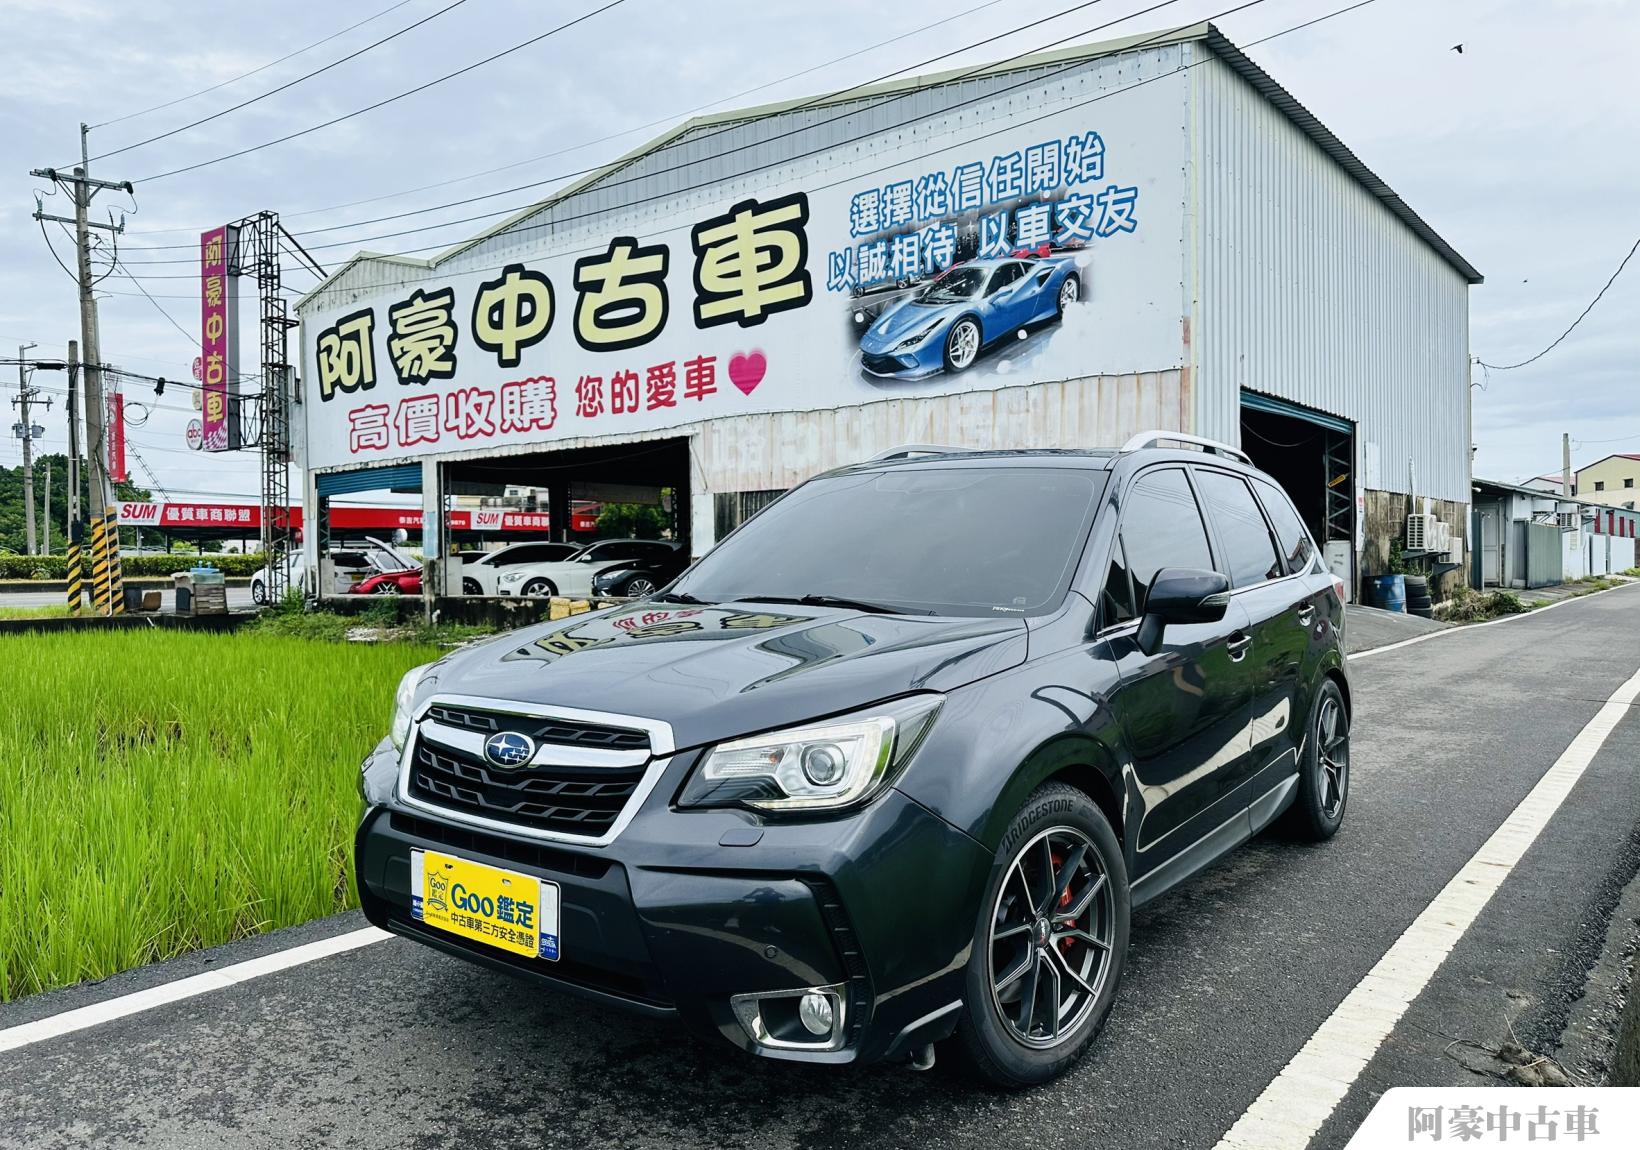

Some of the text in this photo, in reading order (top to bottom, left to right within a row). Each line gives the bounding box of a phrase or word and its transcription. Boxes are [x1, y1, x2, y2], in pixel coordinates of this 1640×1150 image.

[850, 131, 1105, 237] 選擇從信任開始
[827, 185, 1138, 291] 以誠相待 以車交友
[205, 234, 224, 423] 阿豪中古車
[317, 192, 812, 401] 阿豪中古車
[348, 355, 718, 453] 高價收購 您的愛車
[121, 503, 250, 521] SUM 優質車商聯盟
[476, 512, 499, 525] SUM
[430, 877, 446, 891] Goo
[451, 883, 494, 918] Goo
[496, 894, 534, 930] 鑑定
[450, 911, 535, 949] 中古車第三方安全憑證
